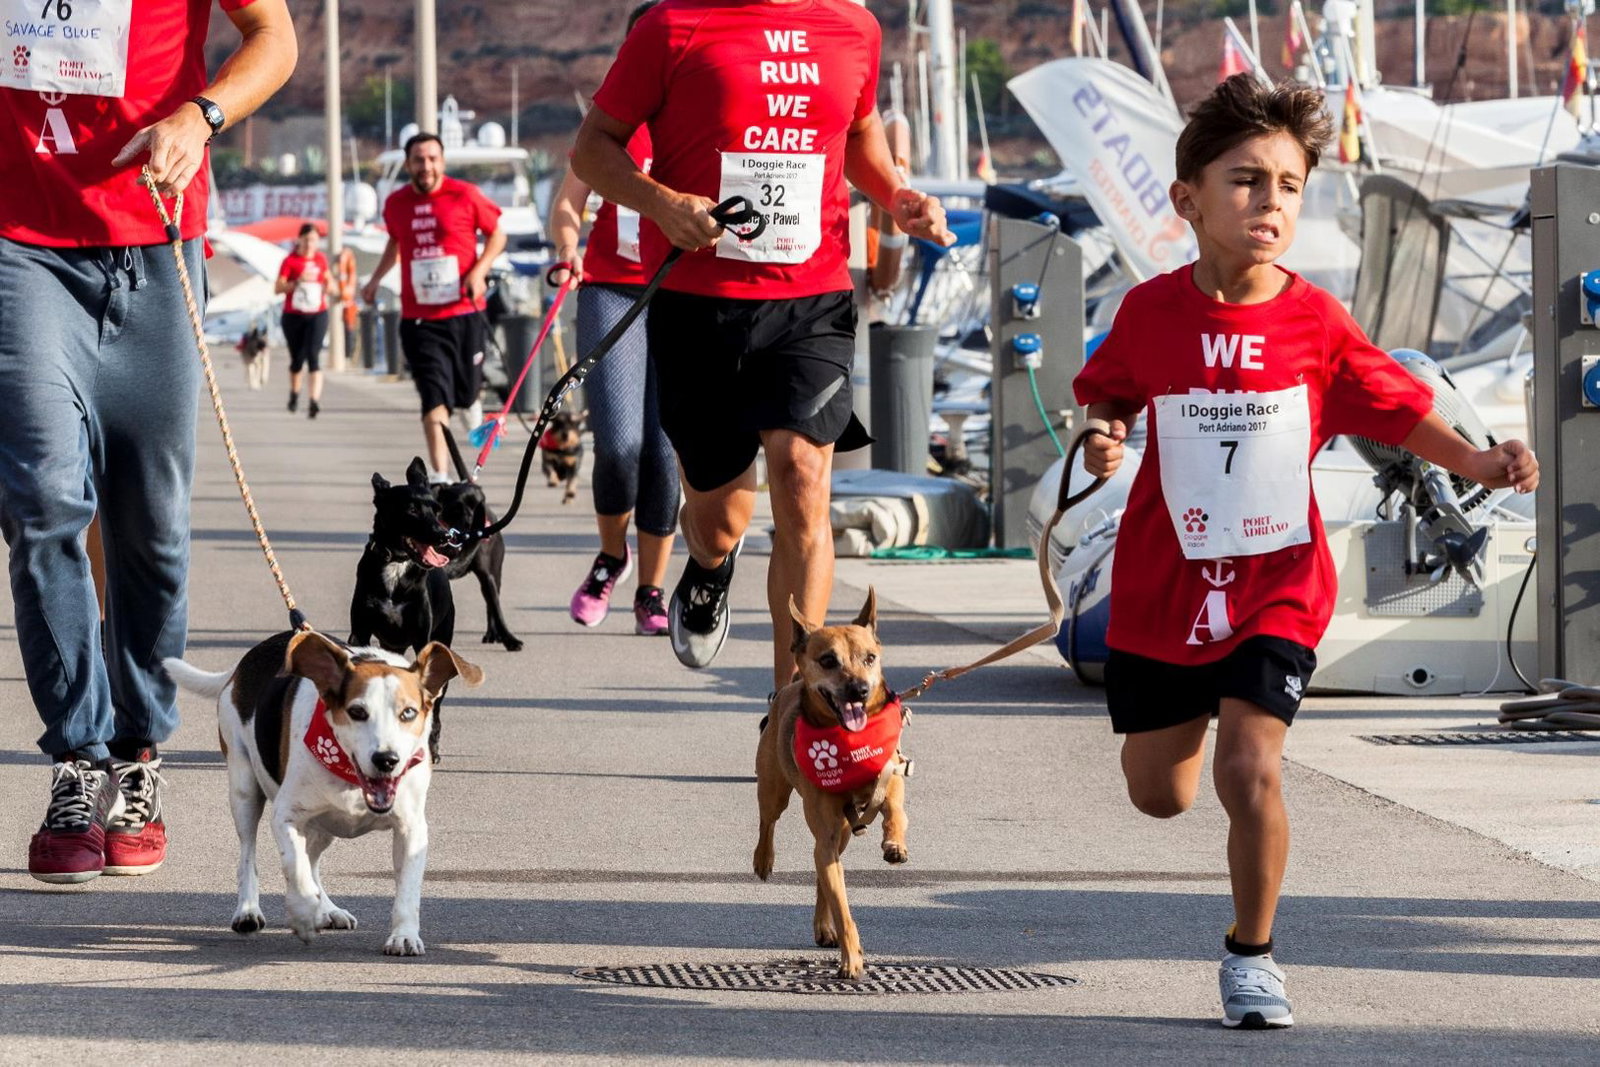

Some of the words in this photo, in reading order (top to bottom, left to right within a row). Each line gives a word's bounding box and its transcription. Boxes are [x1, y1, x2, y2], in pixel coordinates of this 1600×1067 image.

[5, 20, 56, 38] SAVAGE
[63, 26, 101, 40] BLUE
[764, 30, 809, 53] WE
[58, 60, 87, 69] PORT
[760, 61, 820, 85] RUN
[766, 94, 811, 118] WE
[743, 126, 818, 152] CARE
[748, 159, 783, 172] Doggie
[785, 160, 807, 170] Race
[760, 183, 785, 207] 32
[411, 217, 437, 230] RUN
[773, 212, 800, 225] Pawel
[416, 231, 436, 245] WE
[412, 245, 445, 259] CARE
[1201, 333, 1265, 370] WE
[1182, 404, 1185, 418] I
[1188, 403, 1243, 421] Doggie
[1246, 403, 1280, 416] Race
[1199, 422, 1215, 433] Port
[1216, 422, 1246, 432] Adriano
[1248, 421, 1267, 431] 2017
[1220, 440, 1239, 475] 7
[1241, 522, 1289, 538] ADRIANO
[1242, 515, 1271, 528] PORT
[1186, 590, 1234, 645] A
